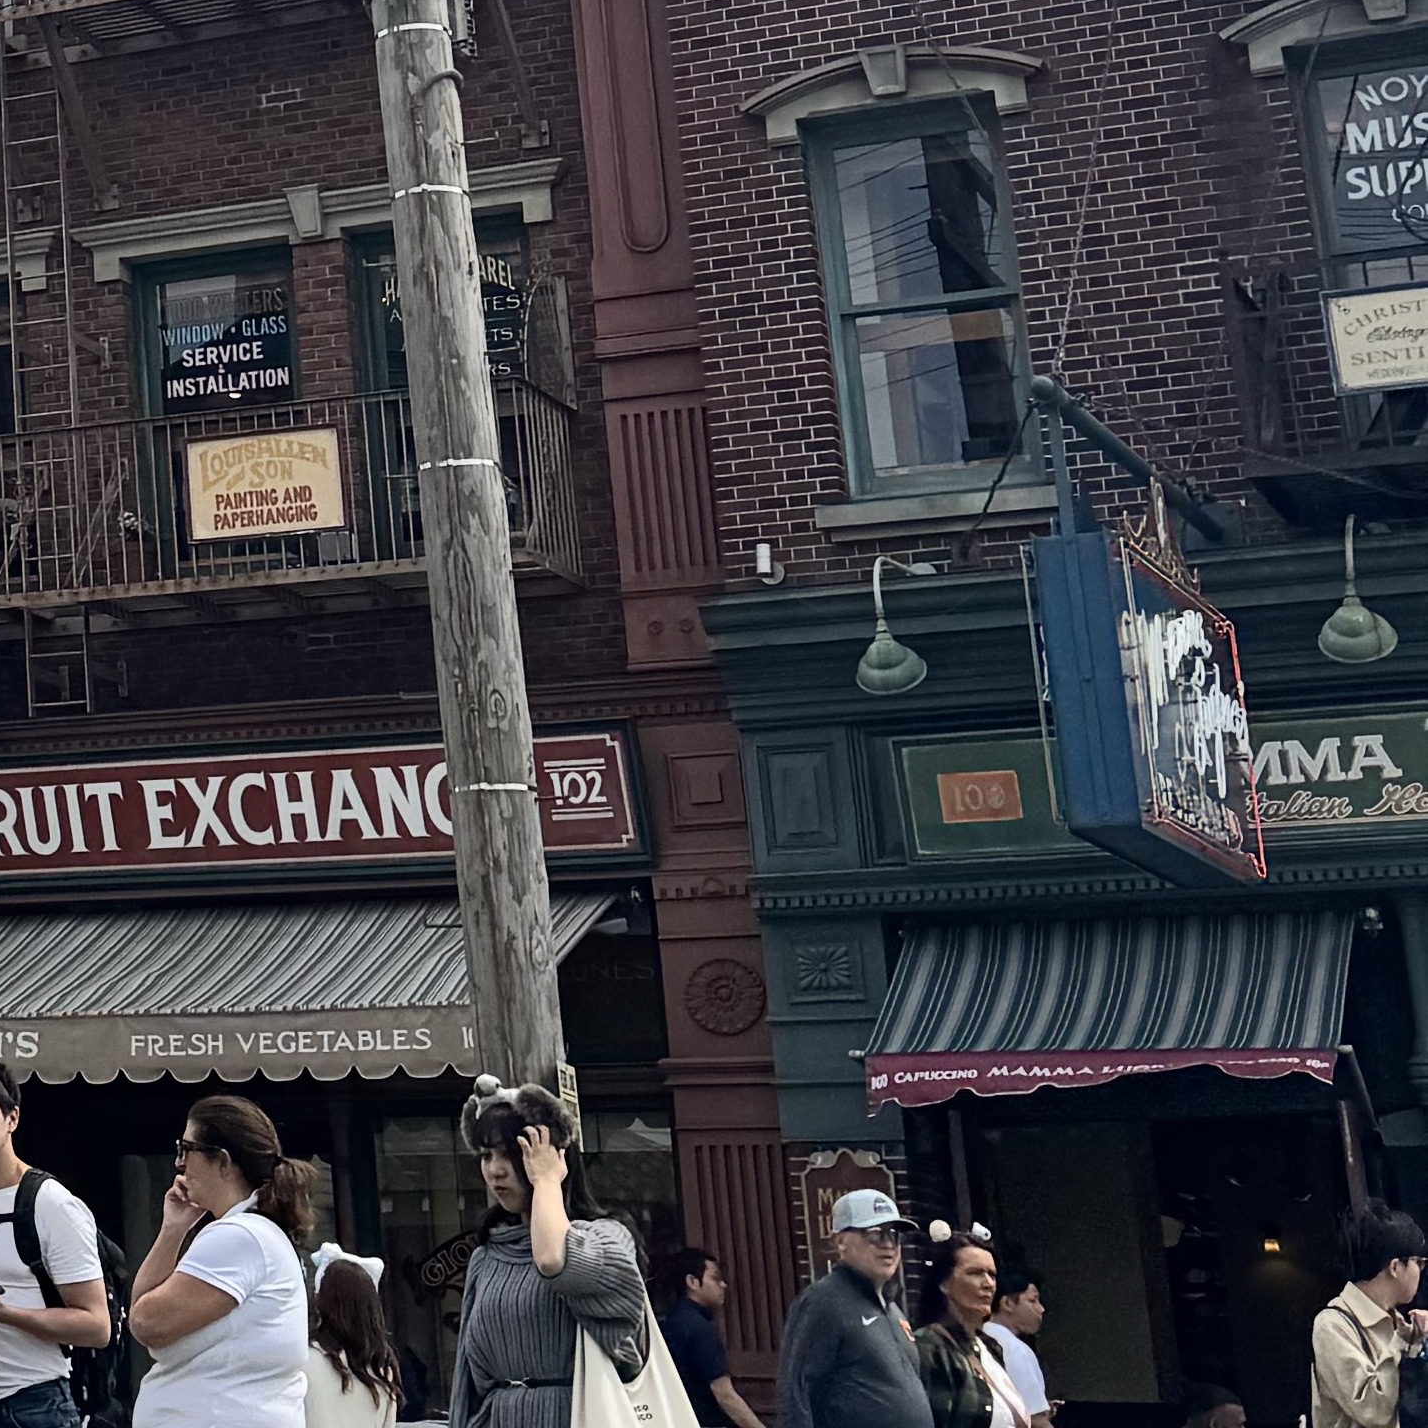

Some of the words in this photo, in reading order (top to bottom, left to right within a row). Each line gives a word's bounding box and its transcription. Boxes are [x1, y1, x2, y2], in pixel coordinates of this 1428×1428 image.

[163, 323, 224, 346] WINDOW
[242, 316, 287, 337] GLASS
[182, 341, 264, 368] SERVICE
[166, 367, 290, 399] INSTALLATION
[199, 438, 257, 492] LOUIS
[249, 459, 295, 488] SON
[215, 488, 278, 511] PAINTING
[283, 485, 312, 504] AND
[214, 504, 318, 531] PAPERHANGING
[138, 762, 454, 851] EXCHANG
[549, 769, 608, 806] 102
[131, 1034, 224, 1057] FRESH
[236, 1029, 432, 1055] VEGETABLES
[894, 1069, 978, 1084] CAPUCCINO
[987, 1065, 1095, 1078] MAMMA
